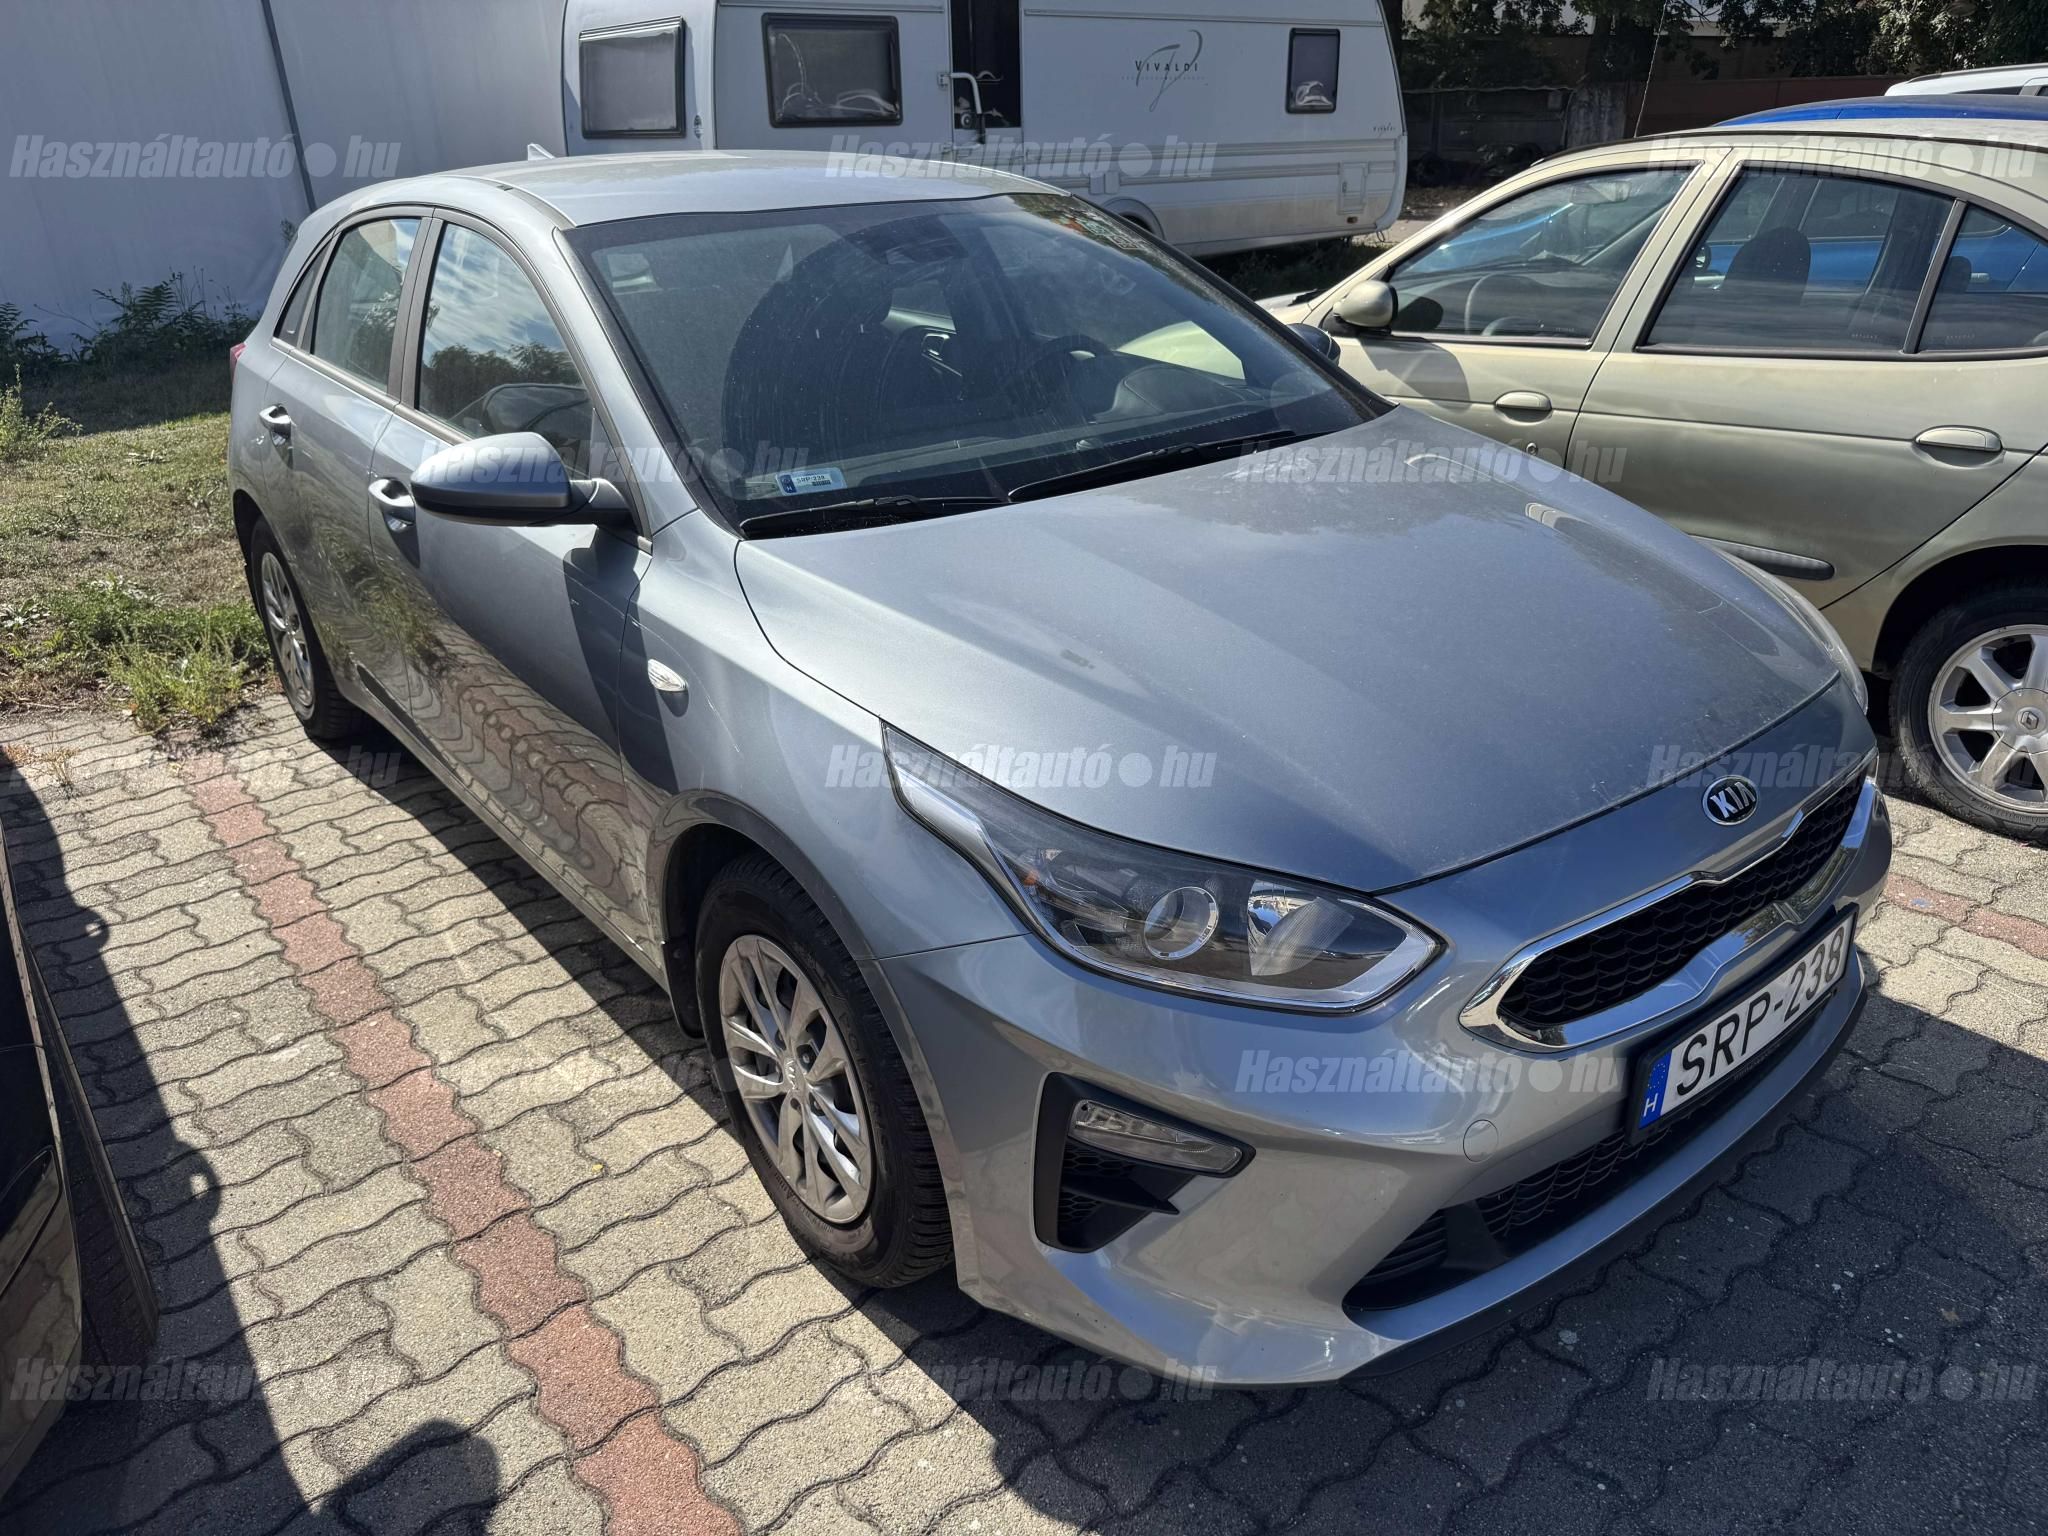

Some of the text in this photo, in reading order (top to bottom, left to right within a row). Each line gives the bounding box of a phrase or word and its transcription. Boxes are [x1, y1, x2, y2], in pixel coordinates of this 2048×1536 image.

[1134, 60, 1198, 72] VIVALDI
[1710, 781, 1756, 819] KIA
[1677, 926, 1845, 1097] SRP-238
[1643, 1093, 1659, 1118] H
